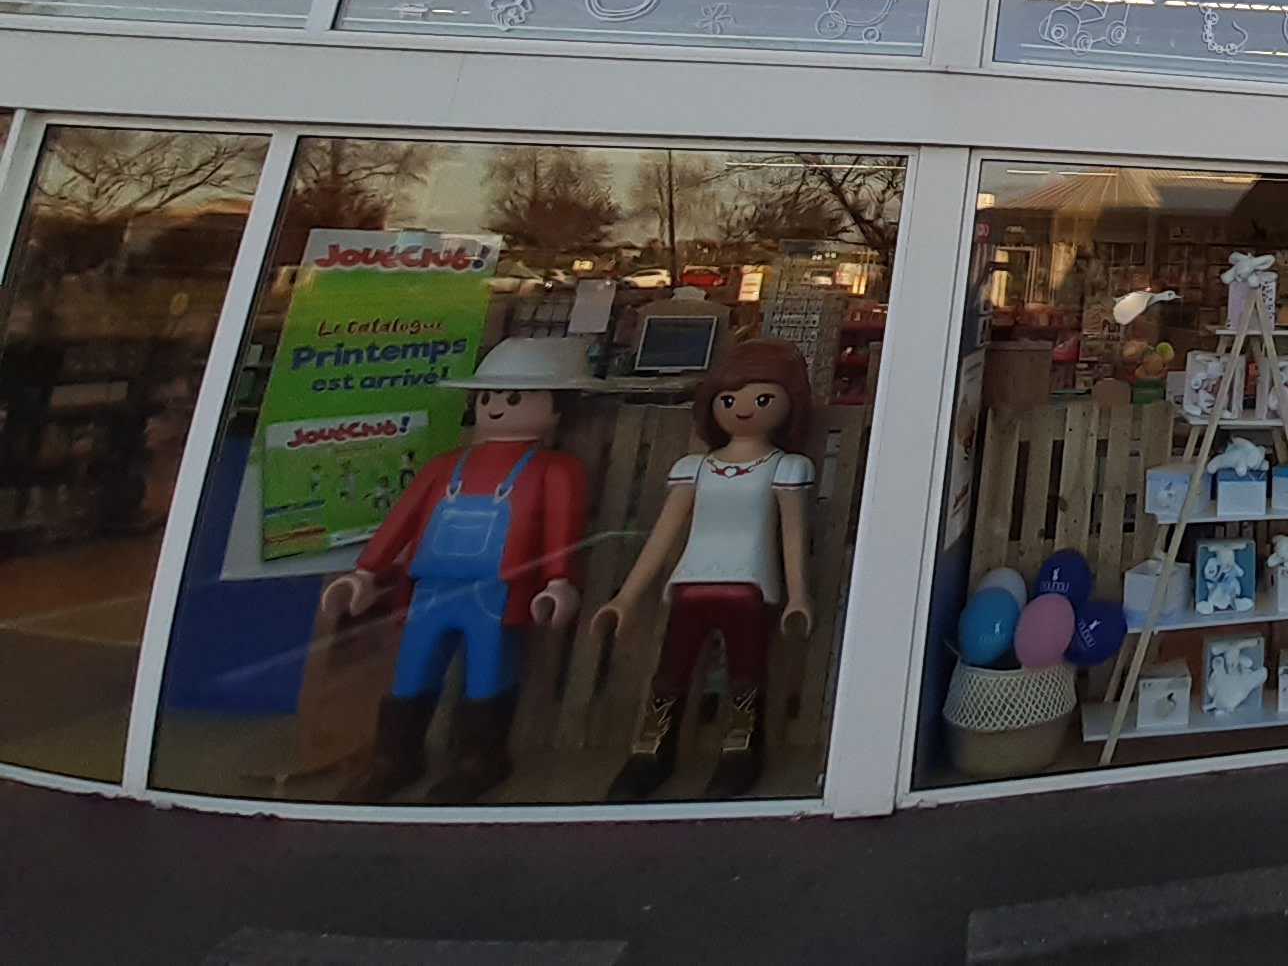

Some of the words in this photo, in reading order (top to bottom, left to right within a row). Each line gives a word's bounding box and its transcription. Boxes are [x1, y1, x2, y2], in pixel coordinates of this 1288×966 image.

[317, 319, 342, 337] Le
[291, 338, 468, 370] Printemps
[311, 375, 354, 392] est
[360, 366, 449, 389] arrivé!
